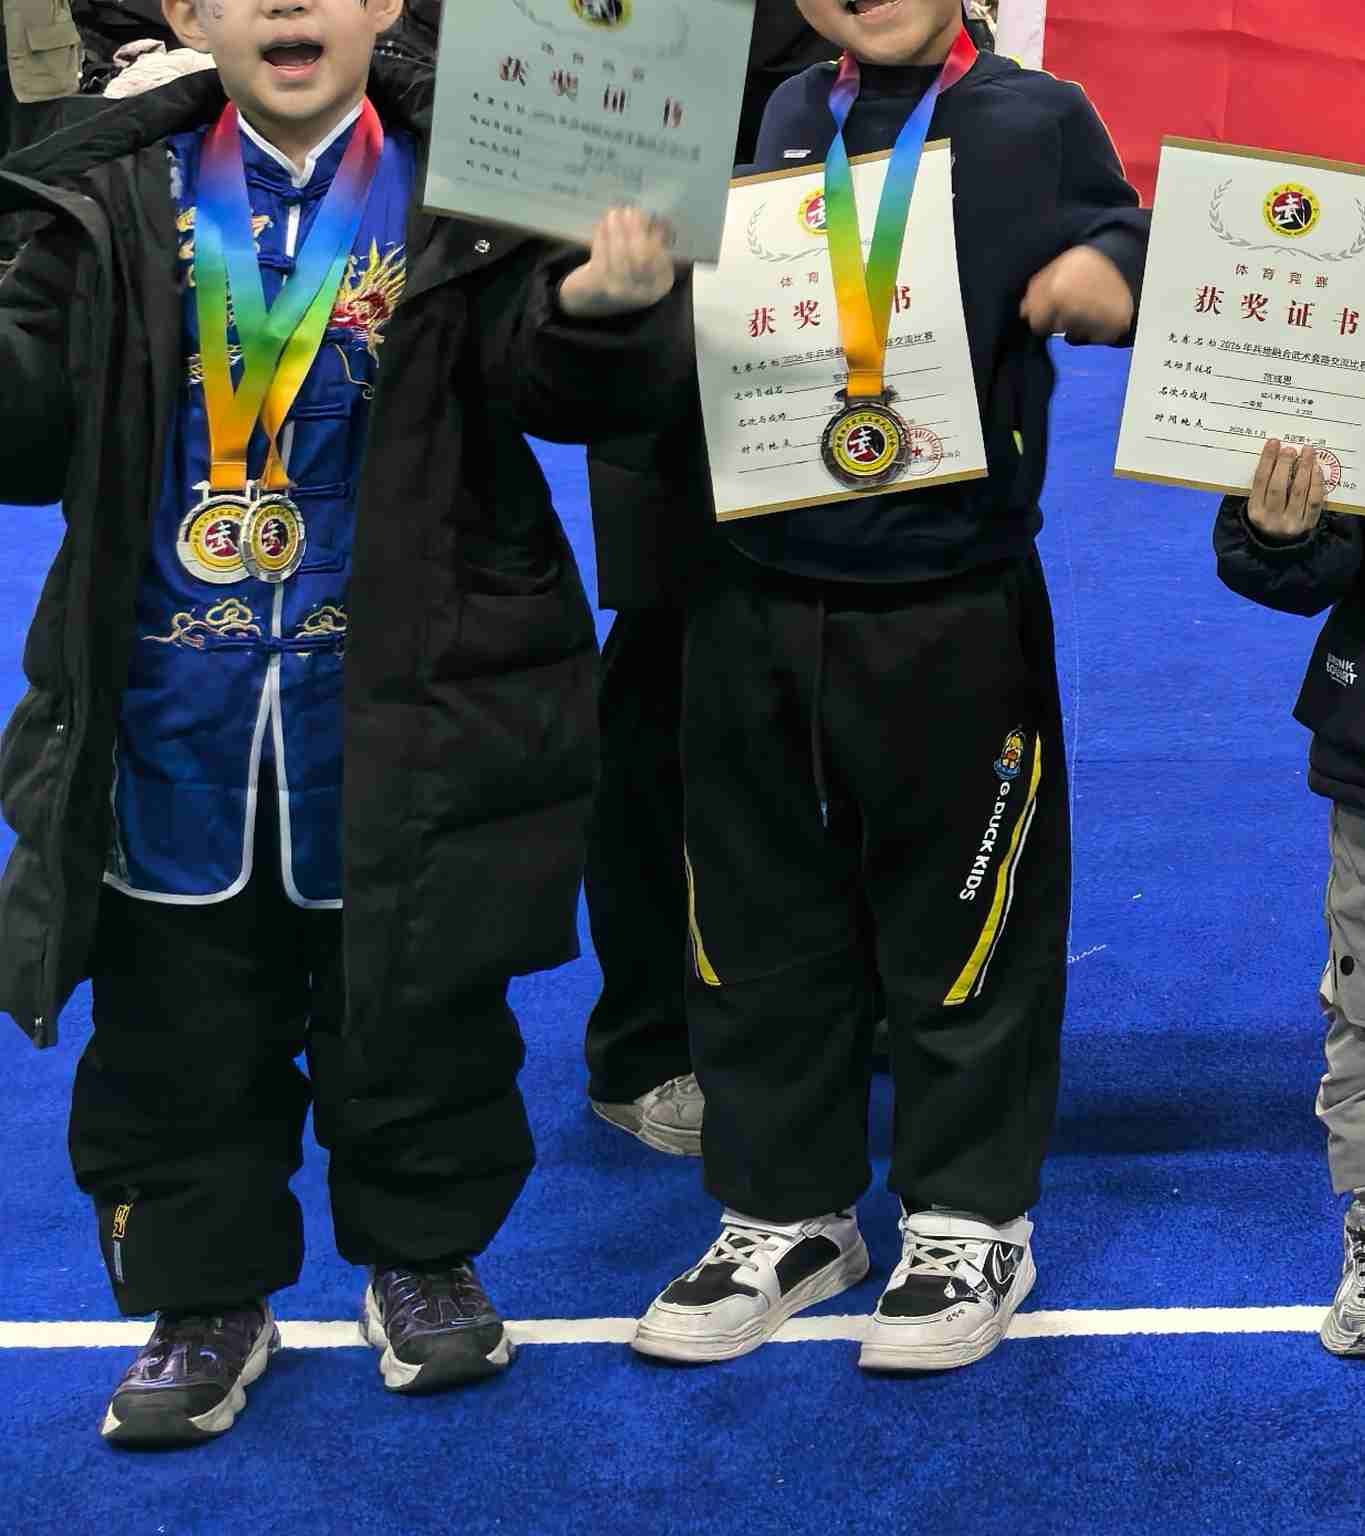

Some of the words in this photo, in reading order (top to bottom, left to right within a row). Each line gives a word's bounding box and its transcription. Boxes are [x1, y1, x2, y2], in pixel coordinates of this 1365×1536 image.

[748, 284, 912, 339] 获奖书
[1195, 286, 1359, 336] 获奖证书
[959, 853, 991, 902] KIDS
